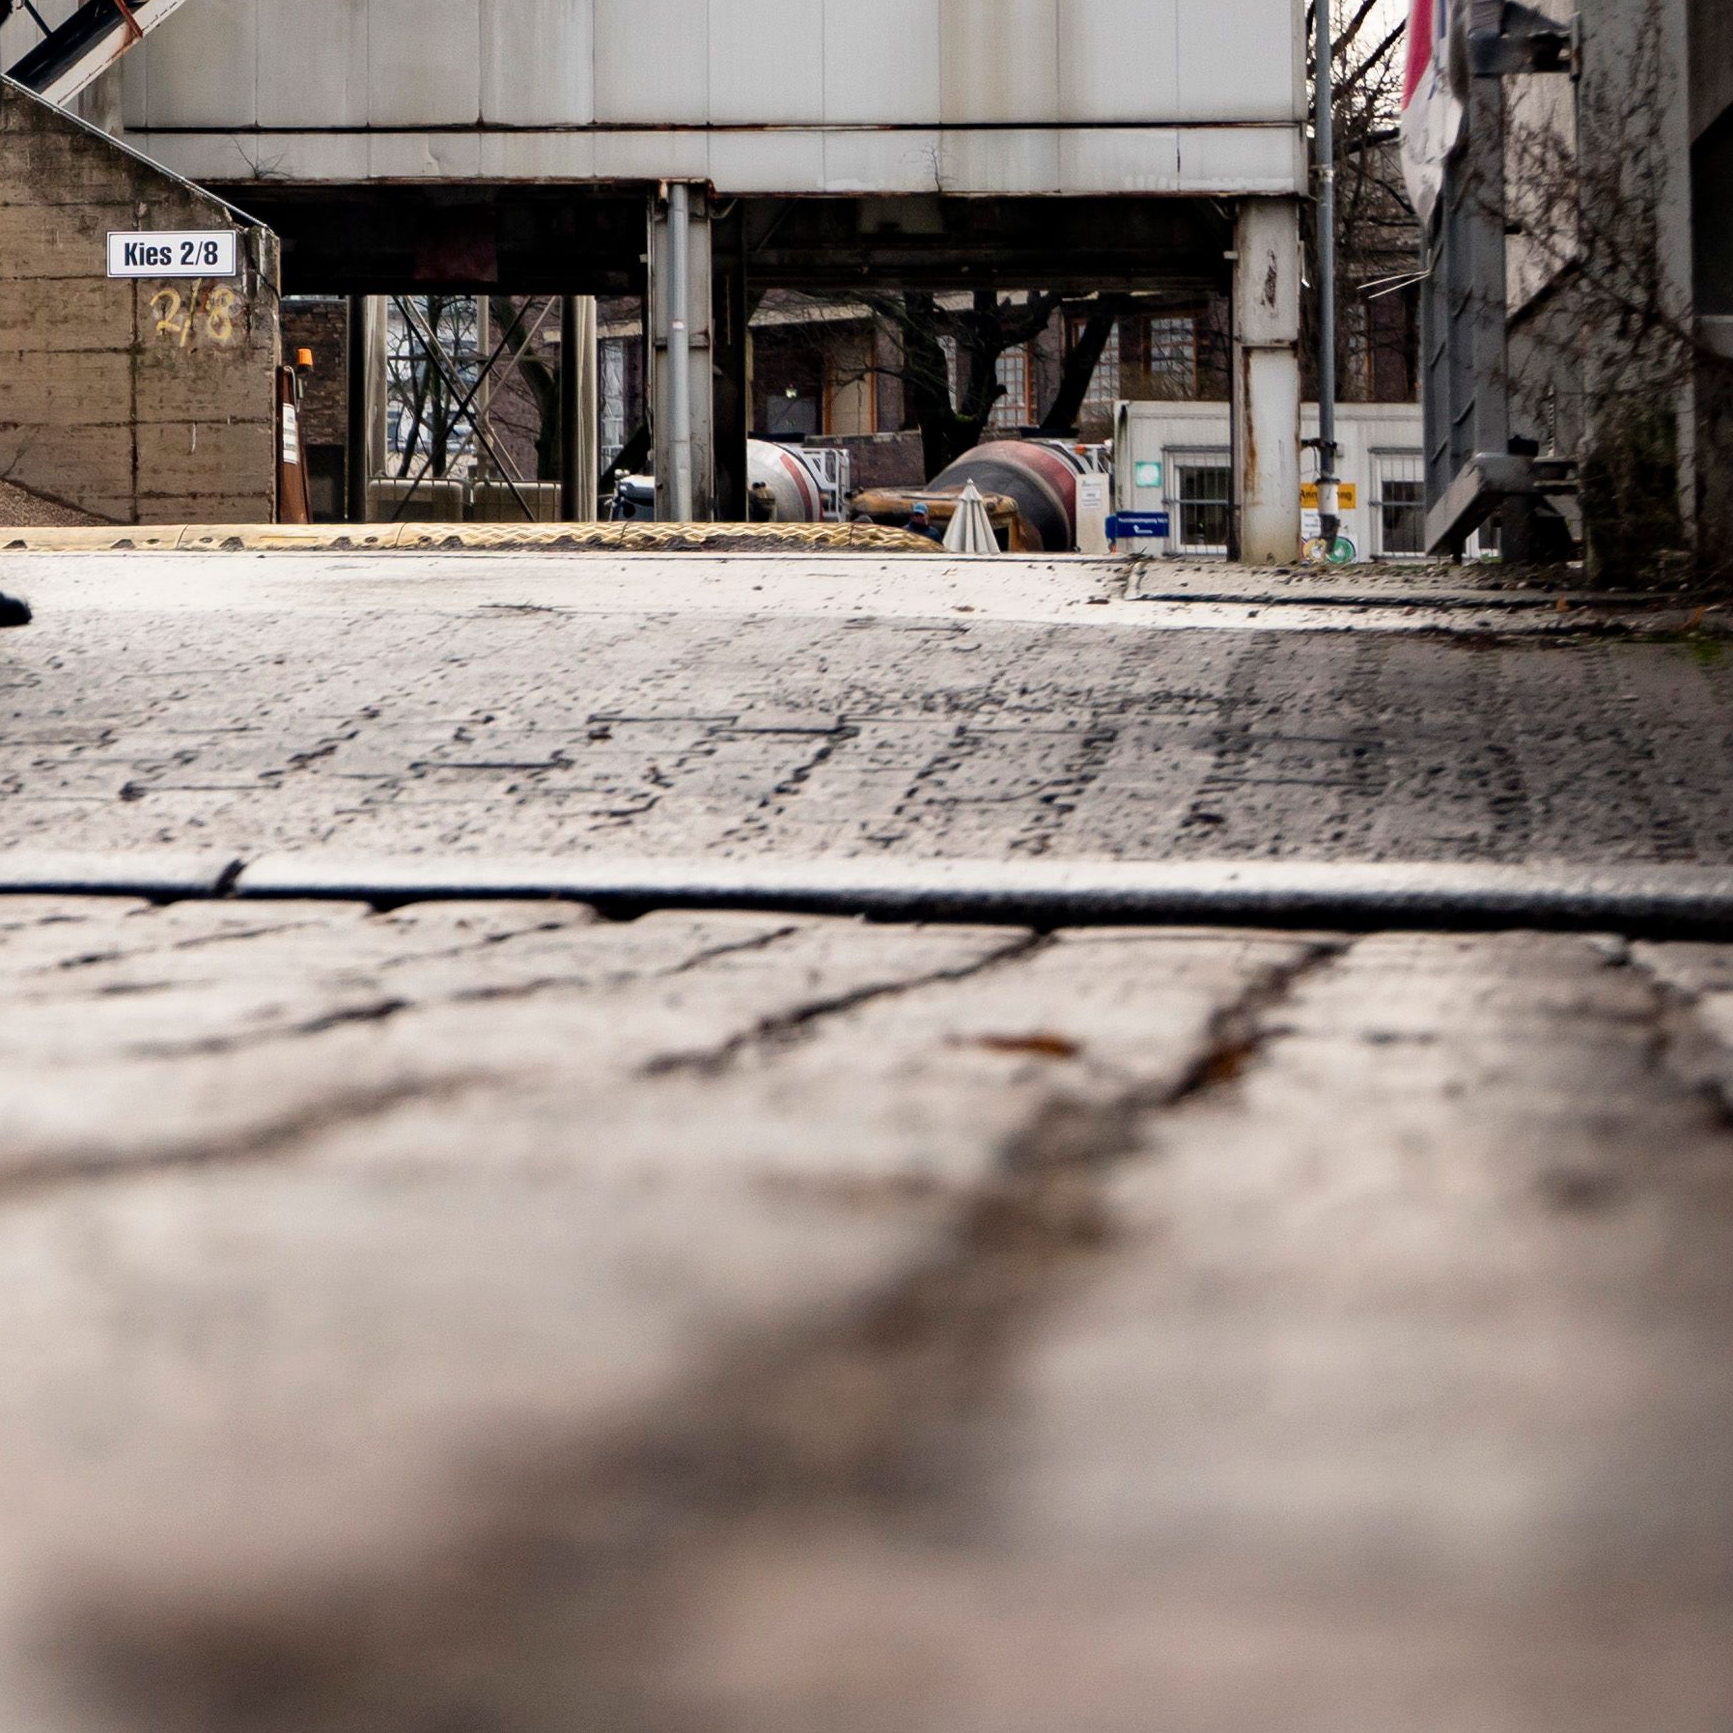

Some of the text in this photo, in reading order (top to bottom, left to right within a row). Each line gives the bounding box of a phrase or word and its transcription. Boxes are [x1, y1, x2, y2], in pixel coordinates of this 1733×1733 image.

[124, 241, 219, 266] Kies 2/8
[149, 278, 235, 347] 2/8
